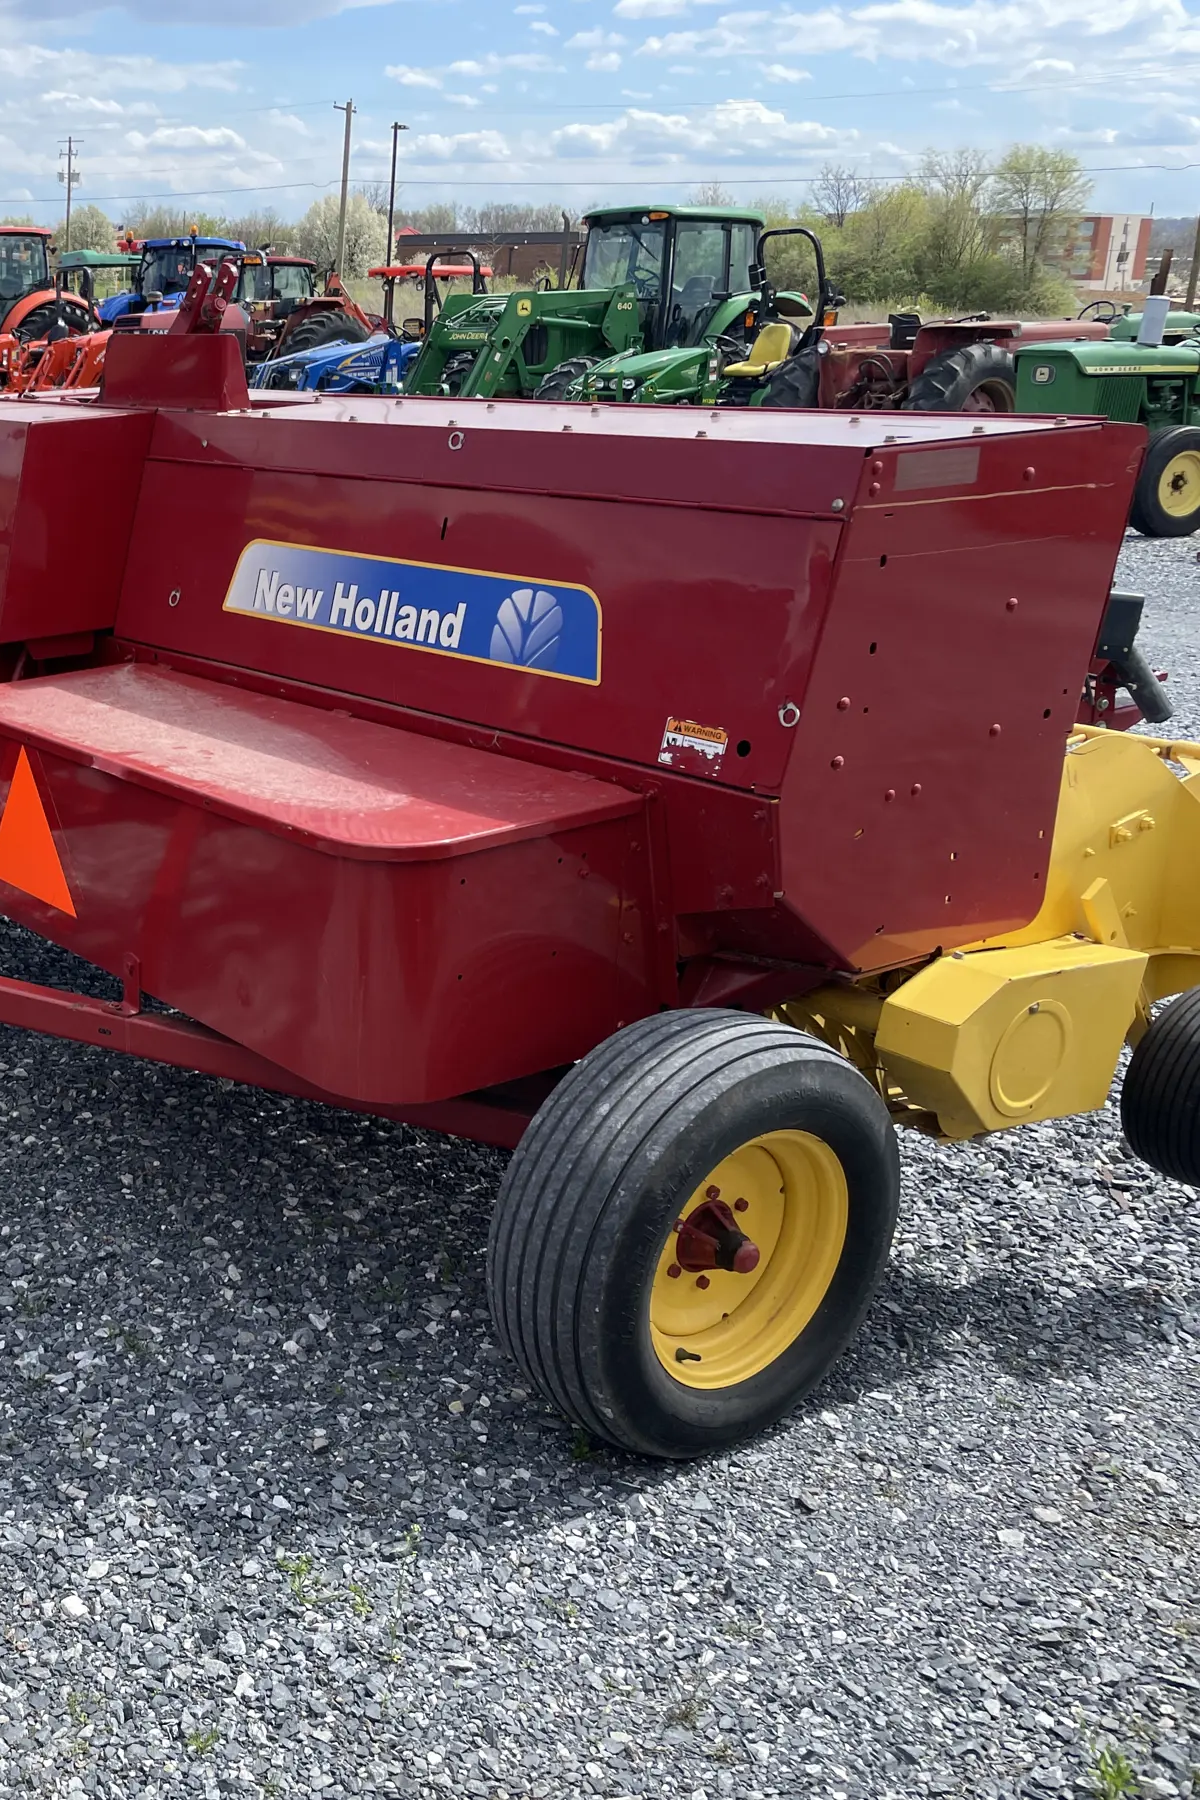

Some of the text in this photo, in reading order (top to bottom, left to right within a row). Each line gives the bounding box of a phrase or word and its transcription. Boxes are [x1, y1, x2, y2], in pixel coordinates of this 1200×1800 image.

[617, 302, 634, 311] 640
[448, 332, 467, 341] JOHN
[252, 569, 467, 649] New Holland
[683, 724, 722, 739] WARNING
